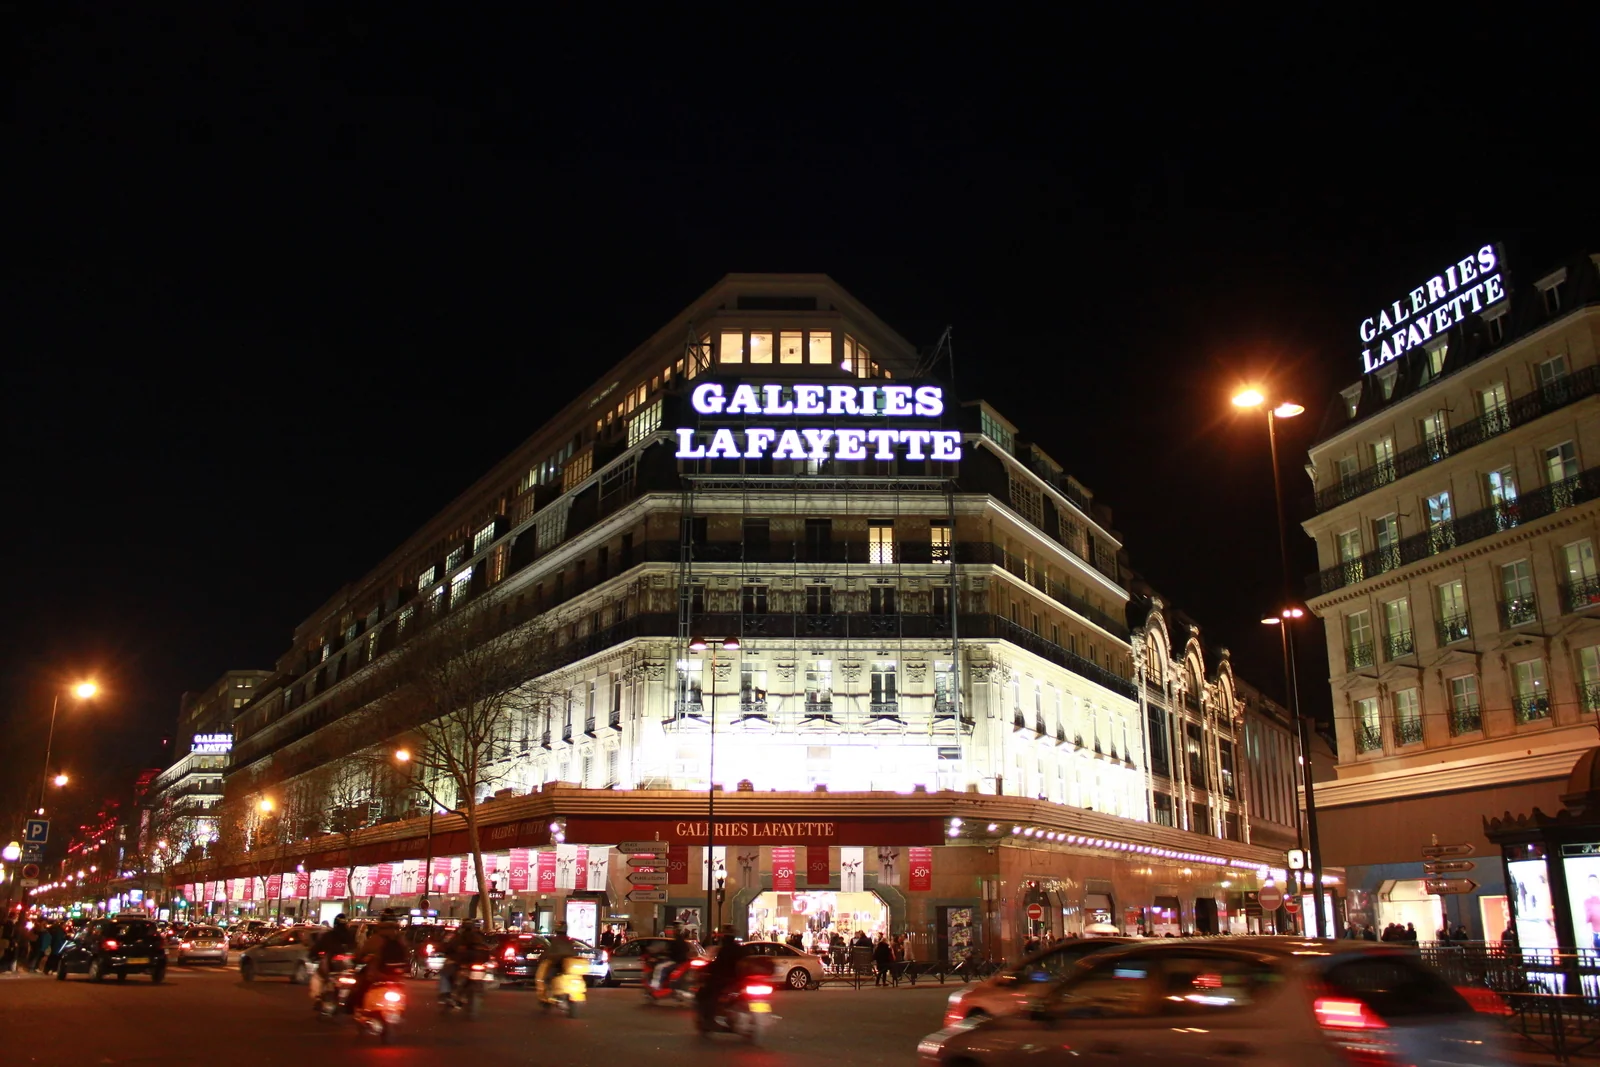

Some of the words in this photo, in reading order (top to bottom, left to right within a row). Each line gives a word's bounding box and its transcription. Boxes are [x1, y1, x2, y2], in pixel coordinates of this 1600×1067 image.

[1359, 244, 1496, 342] GALERIES
[1361, 273, 1505, 374] LAFAYETTE
[691, 383, 944, 416] GALERIES
[675, 428, 962, 460] LAFAYETTE
[194, 734, 233, 743] GALERI
[752, 822, 834, 836] LAFAYETTE
[511, 868, 527, 877] -50%
[540, 872, 556, 880] -50%
[775, 869, 794, 878] -50%
[912, 869, 930, 877] -50%
